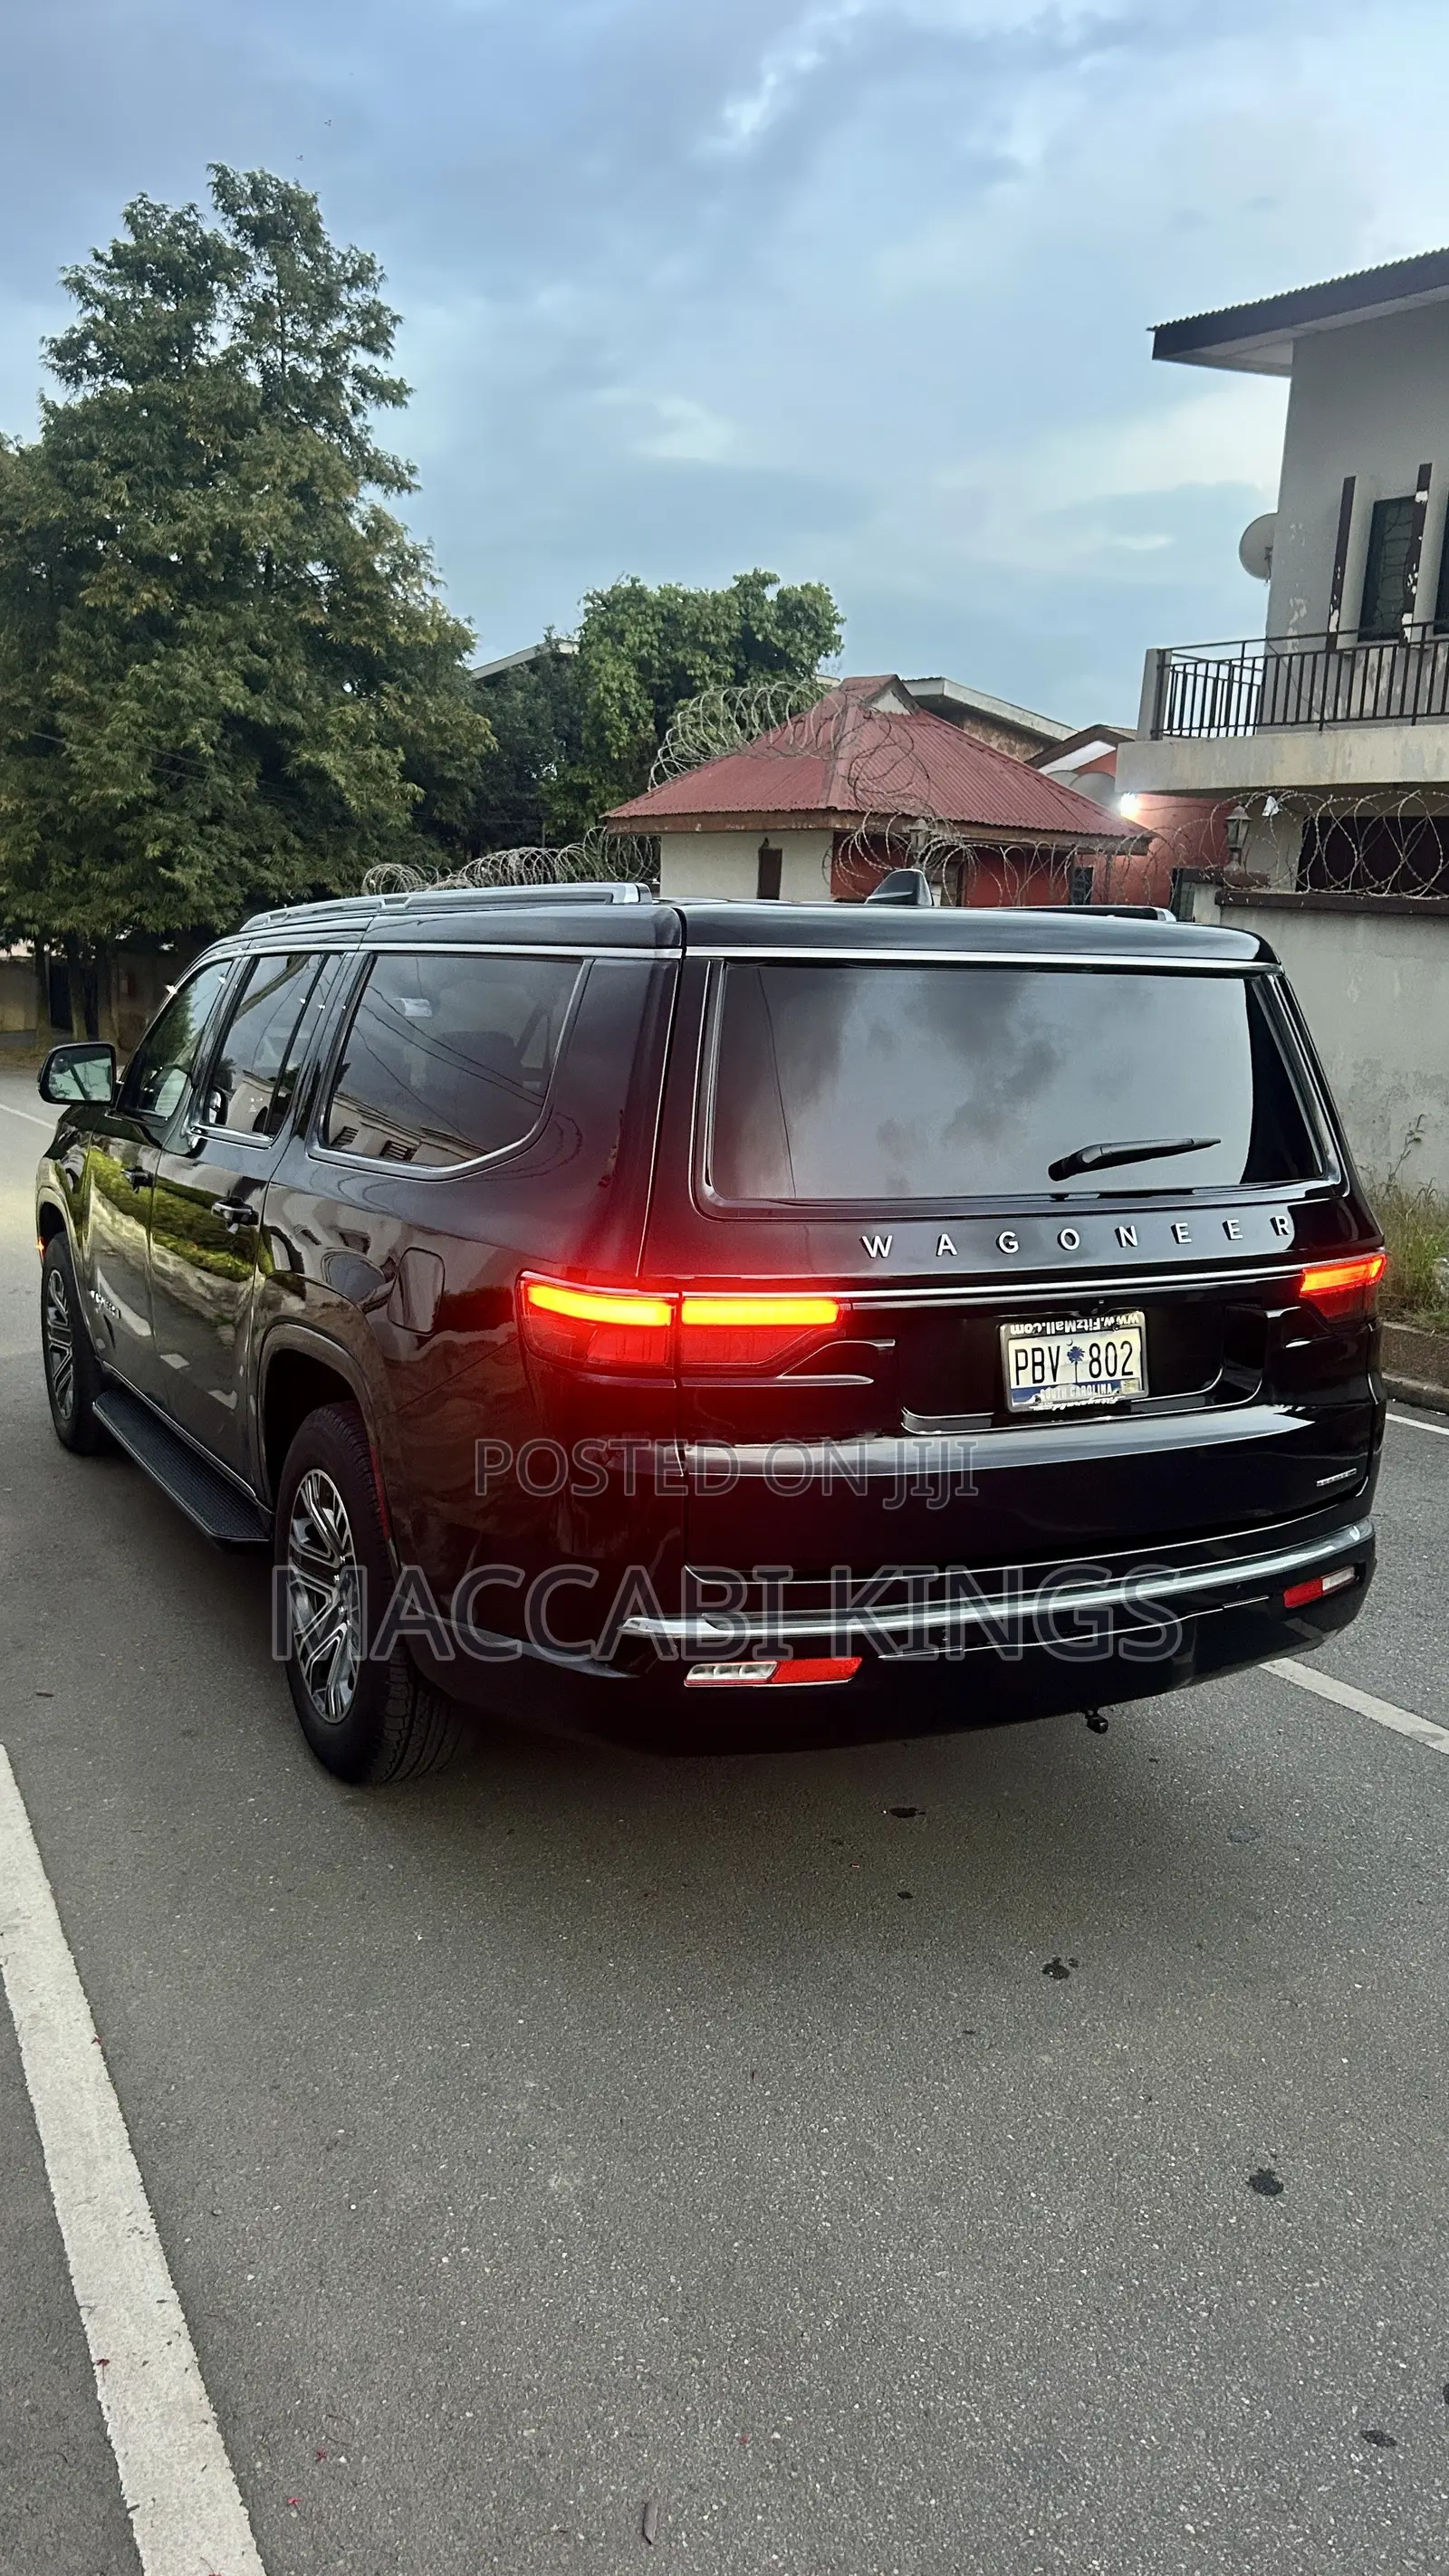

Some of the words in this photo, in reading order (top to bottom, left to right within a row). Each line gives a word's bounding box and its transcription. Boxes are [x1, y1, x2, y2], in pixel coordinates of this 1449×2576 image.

[860, 1216, 1292, 1259] WAGONEER
[1010, 1313, 1140, 1336] www.FitzMall.com
[1014, 1345, 1060, 1386] PBV
[1089, 1340, 1134, 1379] 802
[1040, 1386, 1070, 1400] SOUTH
[1070, 1383, 1112, 1398] CAROLINA
